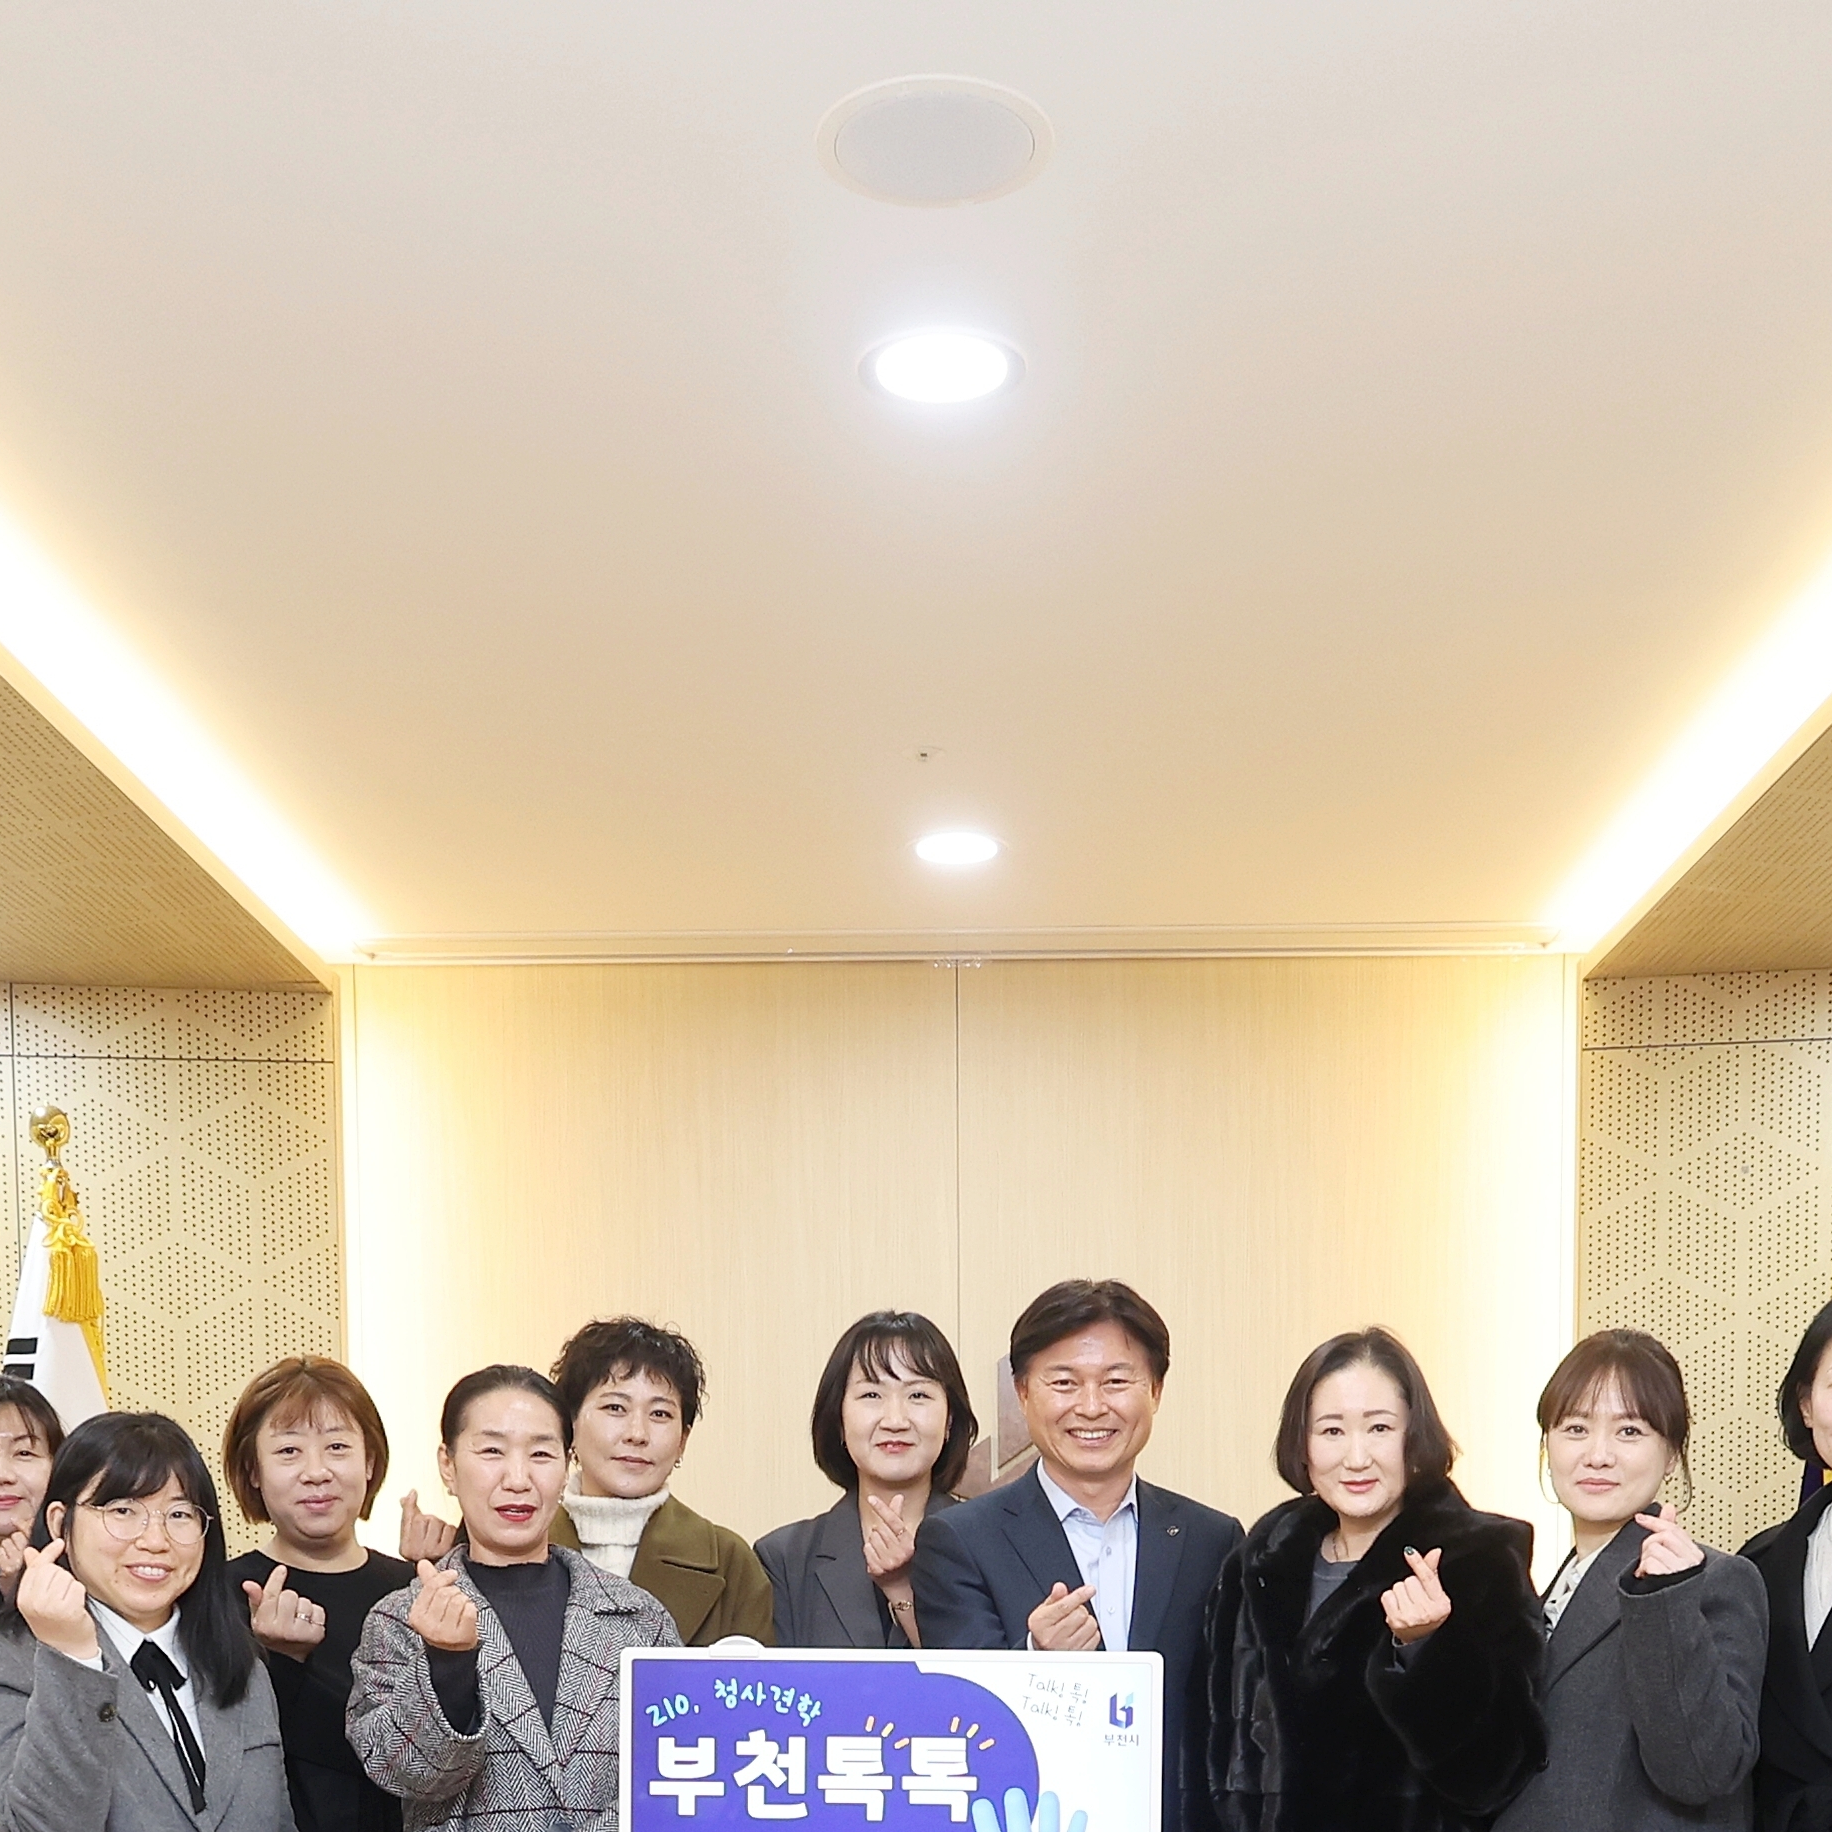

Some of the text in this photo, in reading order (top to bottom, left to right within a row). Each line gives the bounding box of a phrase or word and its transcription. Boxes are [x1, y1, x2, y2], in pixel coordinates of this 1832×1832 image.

[1028, 1673, 1065, 1698] Talk!
[714, 1677, 822, 1727] 청사견학
[1022, 1695, 1059, 1721] Talk!
[1104, 1734, 1139, 1747] 부천시
[649, 1729, 978, 1823] 부천톡톡
